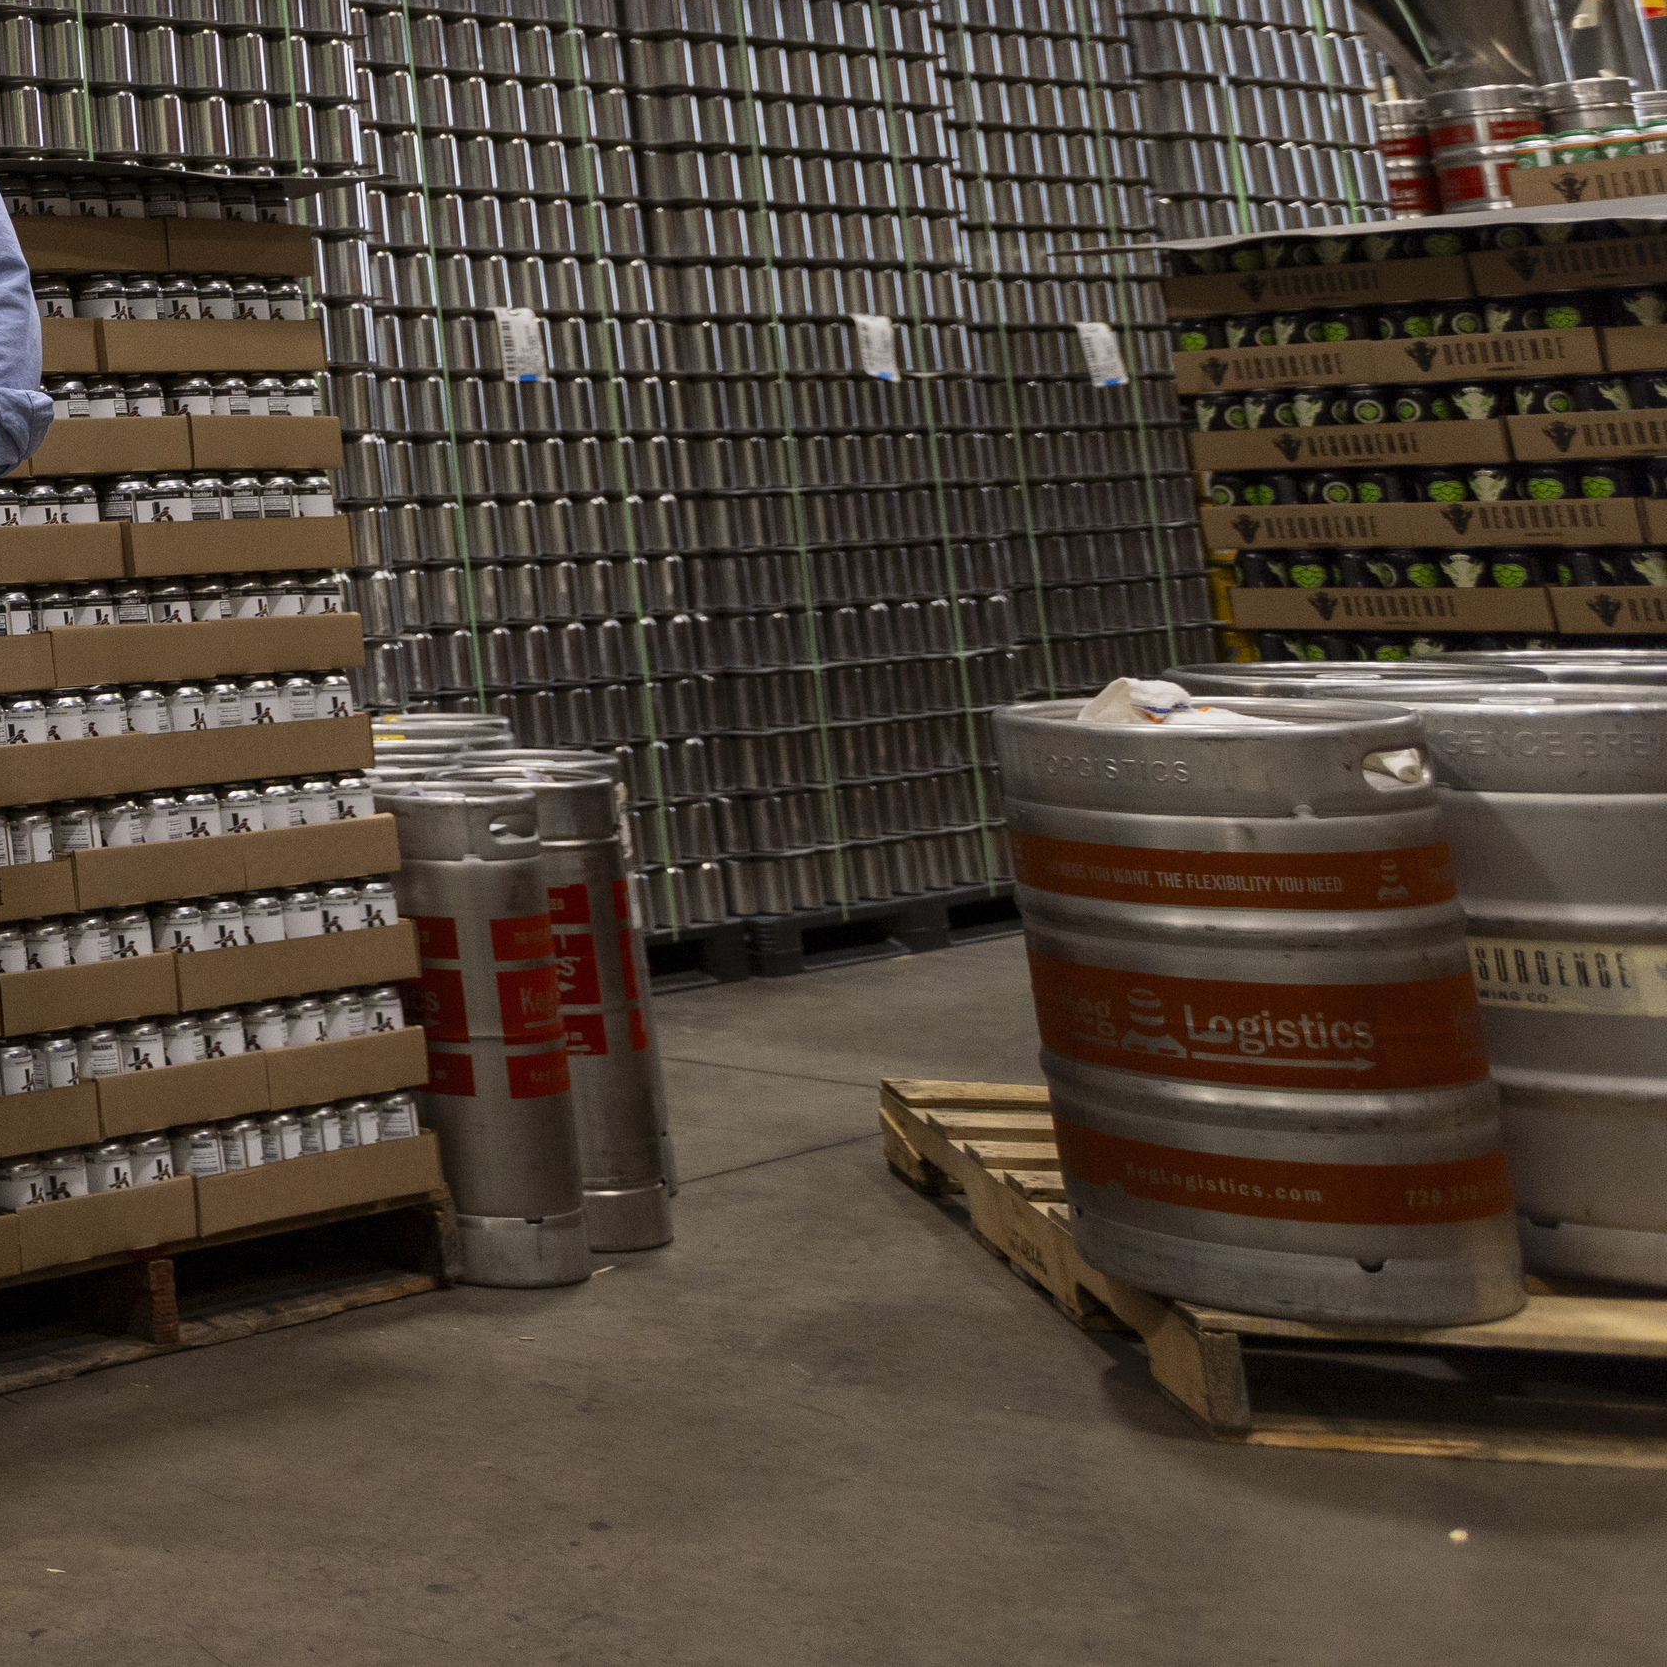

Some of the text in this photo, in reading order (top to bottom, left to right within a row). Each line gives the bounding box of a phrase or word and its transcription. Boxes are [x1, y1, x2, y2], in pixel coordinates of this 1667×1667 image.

[1087, 865, 1111, 882] YOU
[1113, 867, 1154, 889] WANT,
[1155, 870, 1183, 889] THE
[1185, 873, 1273, 893] FLEXIBILITY
[1274, 876, 1305, 893] YOU
[1307, 876, 1343, 893] NEED
[1474, 947, 1631, 988] SURGENCE
[1184, 1003, 1375, 1055] Logistics
